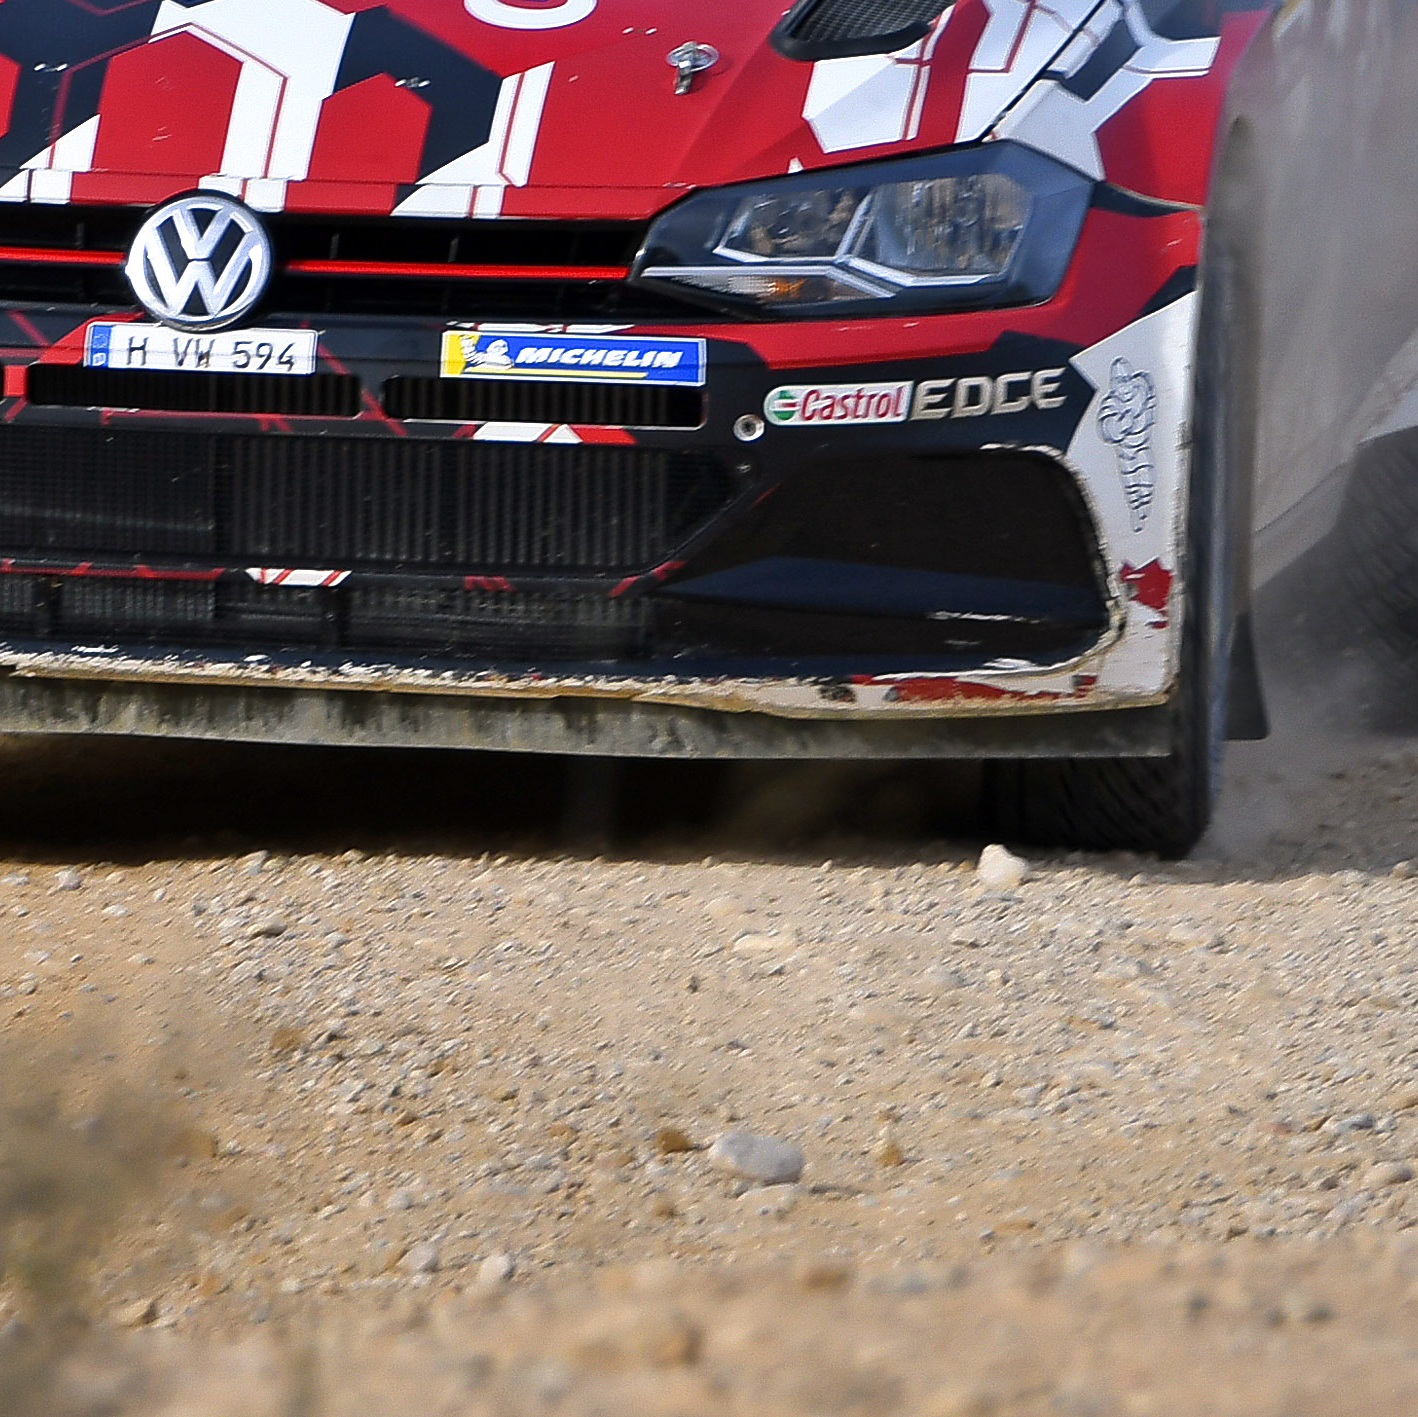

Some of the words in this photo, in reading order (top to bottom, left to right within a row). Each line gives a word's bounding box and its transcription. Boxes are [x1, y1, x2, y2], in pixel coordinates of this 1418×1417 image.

[136, 202, 264, 322] VW
[126, 335, 150, 366] H
[173, 337, 217, 369] VW
[231, 340, 295, 372] 594
[514, 346, 684, 369] MICHELIN
[800, 384, 906, 422] Castrol
[909, 366, 1068, 422] EDGE
